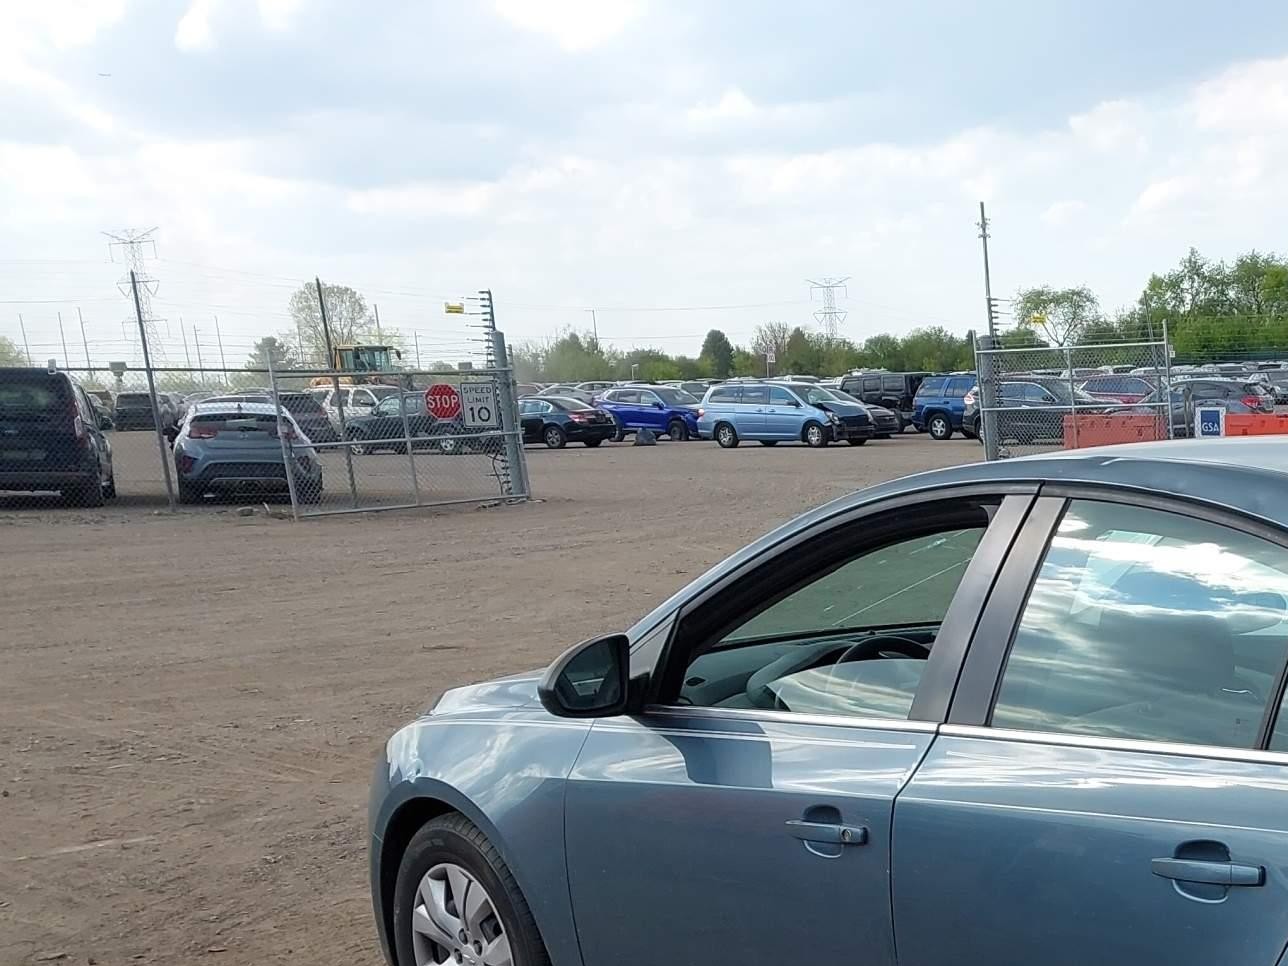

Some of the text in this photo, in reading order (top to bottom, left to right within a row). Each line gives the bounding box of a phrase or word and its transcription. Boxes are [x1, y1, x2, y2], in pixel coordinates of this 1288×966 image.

[463, 386, 492, 394] SPEED
[427, 394, 458, 409] STOP
[467, 396, 489, 404] LIMIT
[469, 406, 491, 423] 10
[1202, 422, 1220, 432] GSA
